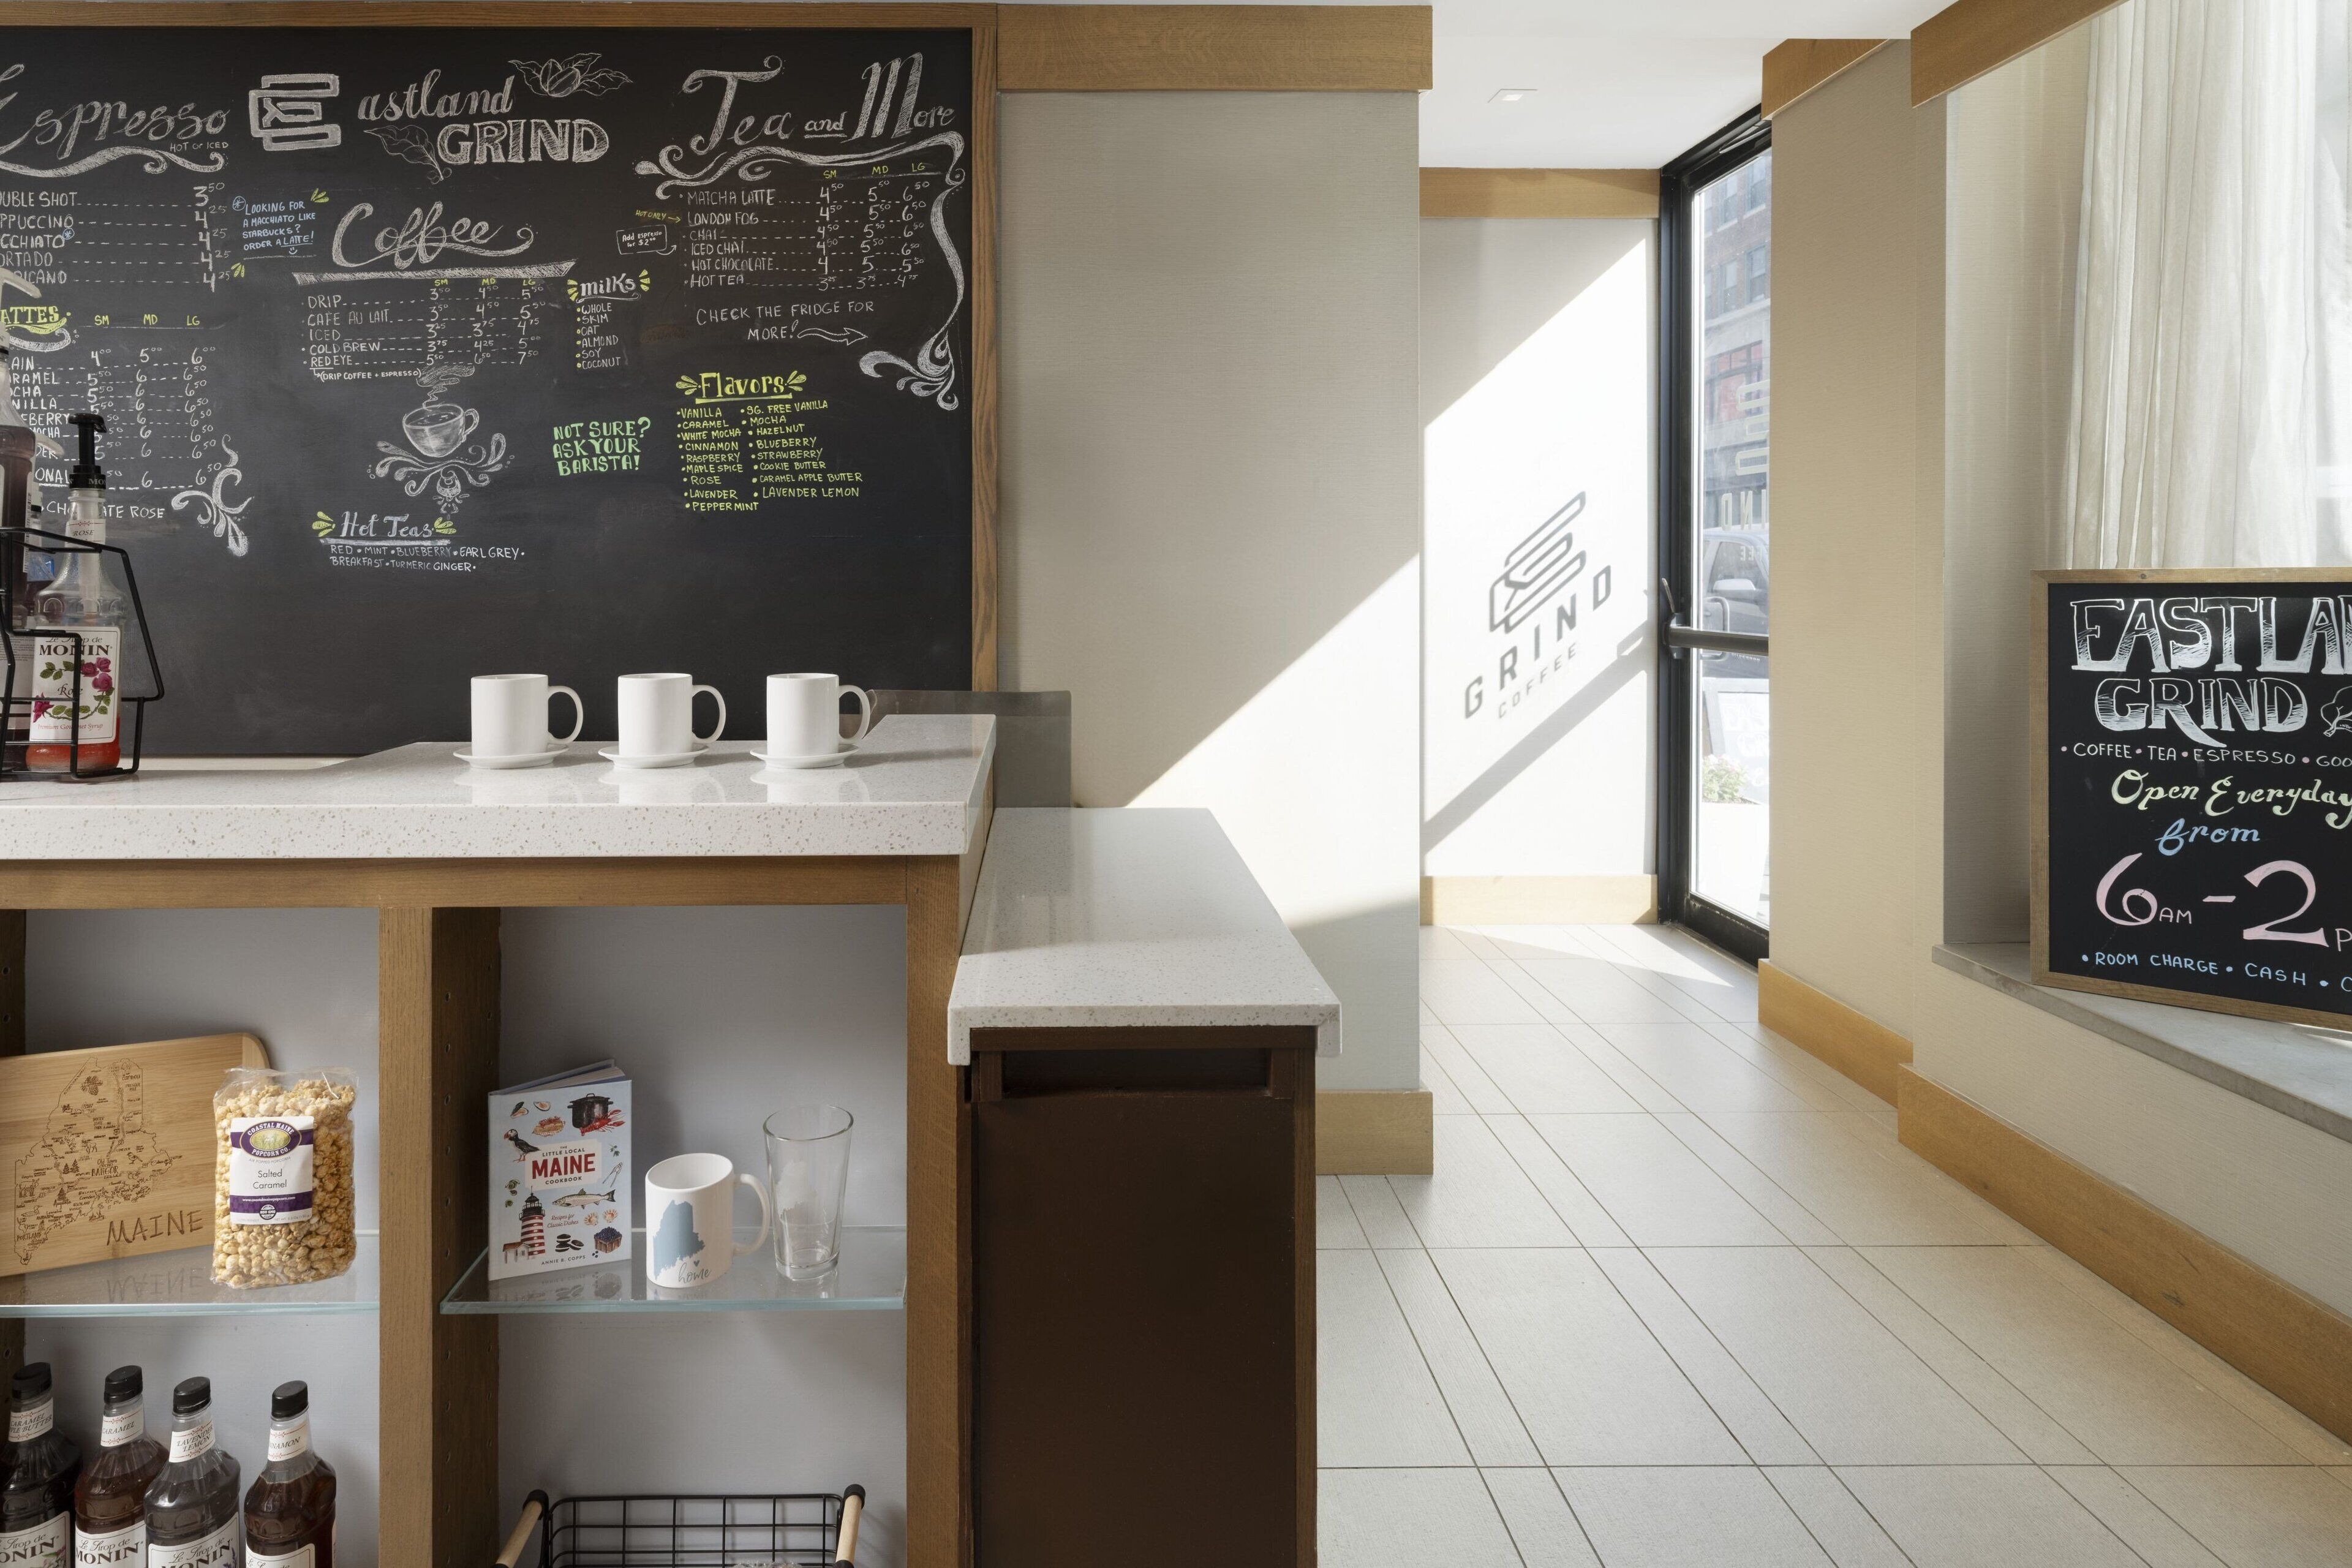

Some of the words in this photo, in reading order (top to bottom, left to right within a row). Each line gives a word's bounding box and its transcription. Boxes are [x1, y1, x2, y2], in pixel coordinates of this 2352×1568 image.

[678, 55, 796, 155] Tea
[805, 111, 848, 131] and
[840, 52, 956, 143] More
[170, 143, 189, 152] HOT
[437, 119, 609, 165] GRIND
[823, 169, 837, 179] SM
[872, 165, 889, 176] MD
[912, 163, 925, 172] LG
[39, 191, 78, 207] SHOT
[687, 190, 737, 205] MATCHA
[742, 189, 775, 205] LATTE
[245, 202, 285, 215] LOOKING
[289, 201, 305, 211] FOR
[0, 214, 74, 229] PPUCCINO
[243, 218, 249, 228] A
[251, 215, 295, 227] MACCHIATO
[298, 213, 316, 221] LIKE
[688, 211, 731, 227] LONDON
[735, 212, 758, 225] FOG
[0, 233, 65, 249] CCHIATO
[244, 241, 273, 251] ORDER
[284, 231, 314, 245] LATTE!
[332, 202, 534, 270] Coffee
[622, 233, 635, 242] Add
[690, 229, 717, 241] CHAI
[692, 243, 717, 255] ICED
[718, 241, 744, 255] CHAI
[692, 258, 713, 271] HOT
[715, 257, 774, 271] CHOCOLATE
[690, 274, 716, 288] HOT
[718, 274, 744, 285] TEA
[307, 295, 342, 309] DRIP
[582, 303, 612, 314] WHOLE
[0, 306, 59, 324] ATTES
[94, 315, 109, 325] SM
[143, 314, 157, 325] MD
[187, 315, 200, 326] LG
[307, 311, 341, 326] CAFE
[349, 311, 363, 325] AU
[369, 309, 390, 323] LAIT
[582, 314, 608, 323] SKIM
[696, 307, 750, 325] CHECK
[756, 305, 781, 317] THE
[791, 301, 840, 317] FRIDGE
[849, 301, 874, 312] FOR
[309, 330, 341, 341] ICED
[582, 325, 600, 336] OAT
[748, 320, 798, 341] MORE!
[582, 335, 619, 347] ALMOND
[310, 344, 341, 355] COLD
[343, 342, 381, 352] BREW
[582, 348, 601, 358] SOY
[311, 357, 331, 368] RED
[333, 356, 352, 366] EYE
[582, 357, 621, 369] COCONUT
[699, 372, 785, 398] Flavors
[680, 407, 722, 418] VANILLA
[747, 405, 764, 415] SG.
[767, 404, 792, 413] FREE
[794, 400, 828, 412] VANILLA
[682, 420, 729, 429] CARAMEL
[750, 415, 786, 426] MOCHA
[553, 423, 584, 440] NOT
[589, 417, 651, 438] SURE?
[681, 431, 707, 441] WHITE
[712, 428, 742, 439] MOCHA
[757, 424, 805, 436] HAZELNUT
[553, 439, 588, 458] ASK
[588, 437, 641, 454] YOUR
[685, 442, 739, 451] CINNAMON
[756, 437, 817, 449] BLUEBERRY
[687, 452, 740, 463] RASPBERRY
[757, 448, 823, 461] STRAWBERRY
[557, 454, 640, 476] BARISTA!
[687, 464, 715, 473] MAPLE
[717, 464, 744, 472] SPICE
[794, 461, 826, 470] BUTTER
[691, 476, 722, 484] ROSE
[760, 474, 795, 483] CARAMEL
[798, 473, 823, 482] APPLE
[827, 472, 863, 482] BUTTER
[690, 489, 738, 499] LAVENDER
[763, 487, 818, 499] LAVENDER
[822, 488, 859, 497] LEMON
[130, 505, 165, 519] ROSE
[340, 511, 379, 538] Hot
[383, 513, 434, 538] Teas
[331, 545, 353, 556] RED
[364, 546, 388, 556] MINT
[397, 546, 452, 557] BLUEBERRY
[460, 547, 486, 559] EARL
[489, 547, 519, 560] GREY
[330, 556, 384, 568] BREAKFAST
[390, 560, 431, 570] TURMERIC
[433, 562, 472, 572] GINGER
[2070, 595, 2352, 674] EASTLA
[1465, 565, 1611, 719] GRIND
[1498, 643, 1577, 719] COFFEE
[2095, 677, 2308, 747] GRIND
[2073, 743, 2133, 759] COFFEE
[2147, 745, 2176, 761] TEA
[2193, 749, 2296, 764] ESPRESSO
[2112, 769, 2199, 810] Open
[2155, 818, 2261, 856] from
[2095, 952, 2138, 965] ROOM
[2150, 954, 2218, 974] CHARGE
[2245, 963, 2306, 986] CASH
[247, 1122, 274, 1136] COASTAL
[276, 1123, 295, 1135] MAINE
[252, 1148, 279, 1158] POPCORN
[92, 1165, 119, 1177] BANGOR
[258, 1168, 282, 1178] Salted
[532, 1153, 595, 1180] MAINE
[253, 1179, 287, 1189] Caramel
[545, 1176, 582, 1185] COOKBOOK
[107, 1210, 203, 1246] MAINE
[678, 1262, 711, 1283] home
[177, 1425, 214, 1447] LAVENDER
[183, 1433, 211, 1452] LEMON
[90, 1540, 115, 1551] Sirop
[187, 1544, 213, 1560] Sirop
